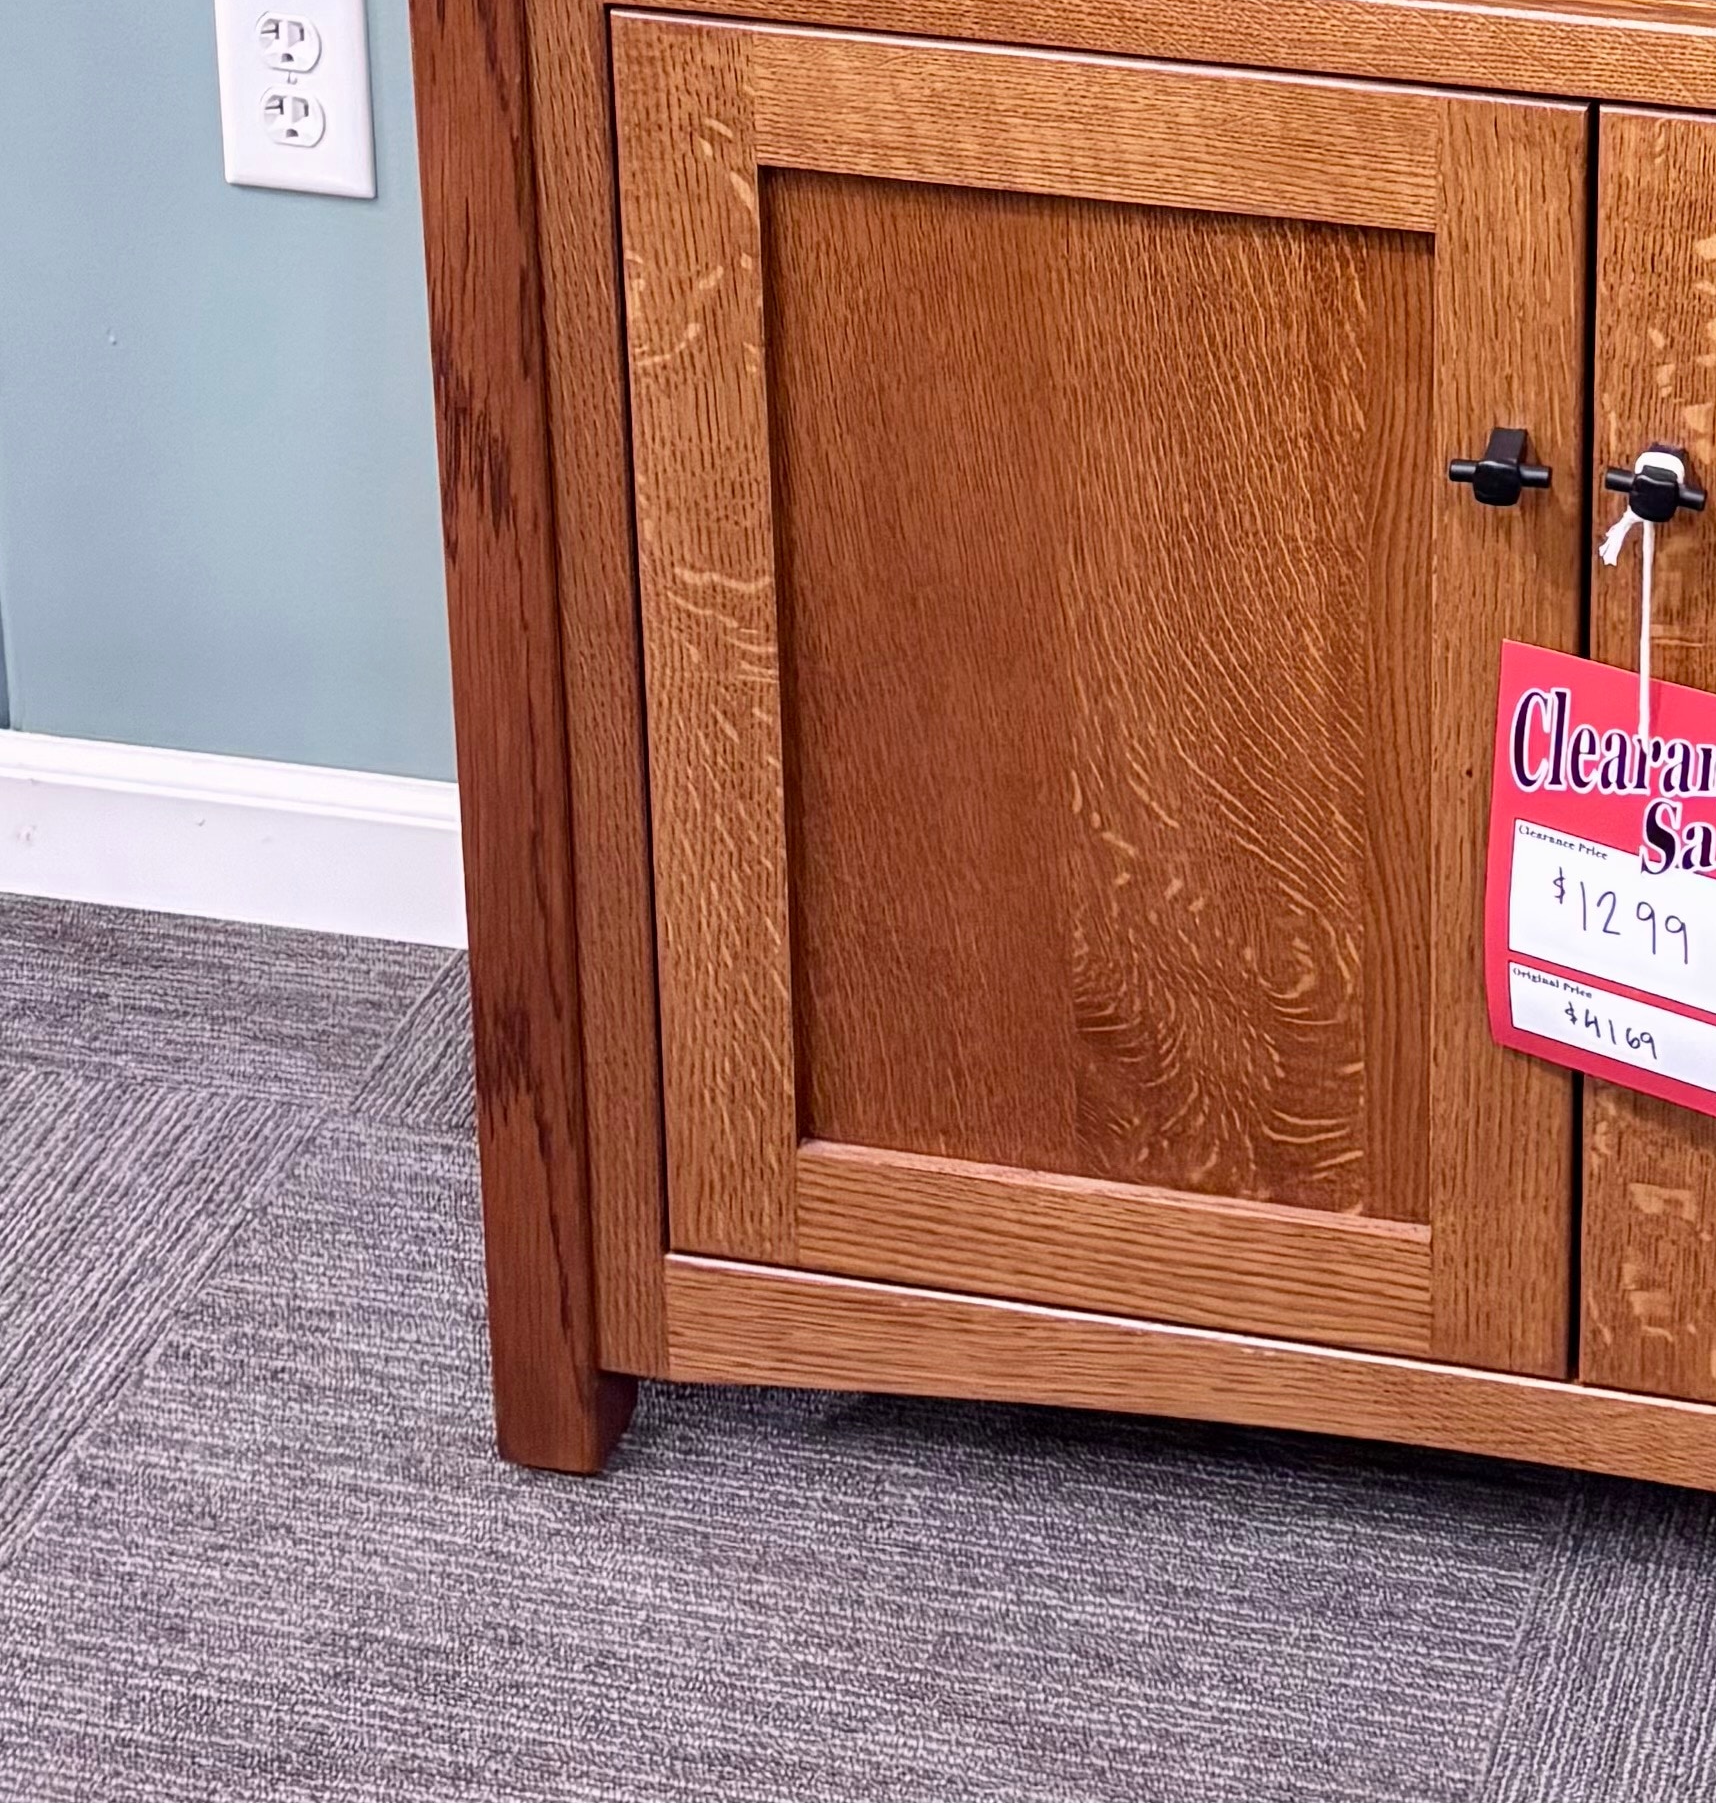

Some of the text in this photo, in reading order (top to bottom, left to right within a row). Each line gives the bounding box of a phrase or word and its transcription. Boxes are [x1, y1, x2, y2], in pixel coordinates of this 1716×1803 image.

[1518, 824, 1608, 860] Clearance Price
[1552, 865, 1688, 965] $1299
[1512, 967, 1593, 999] Original Price
[1564, 1000, 1658, 1060] $4169
